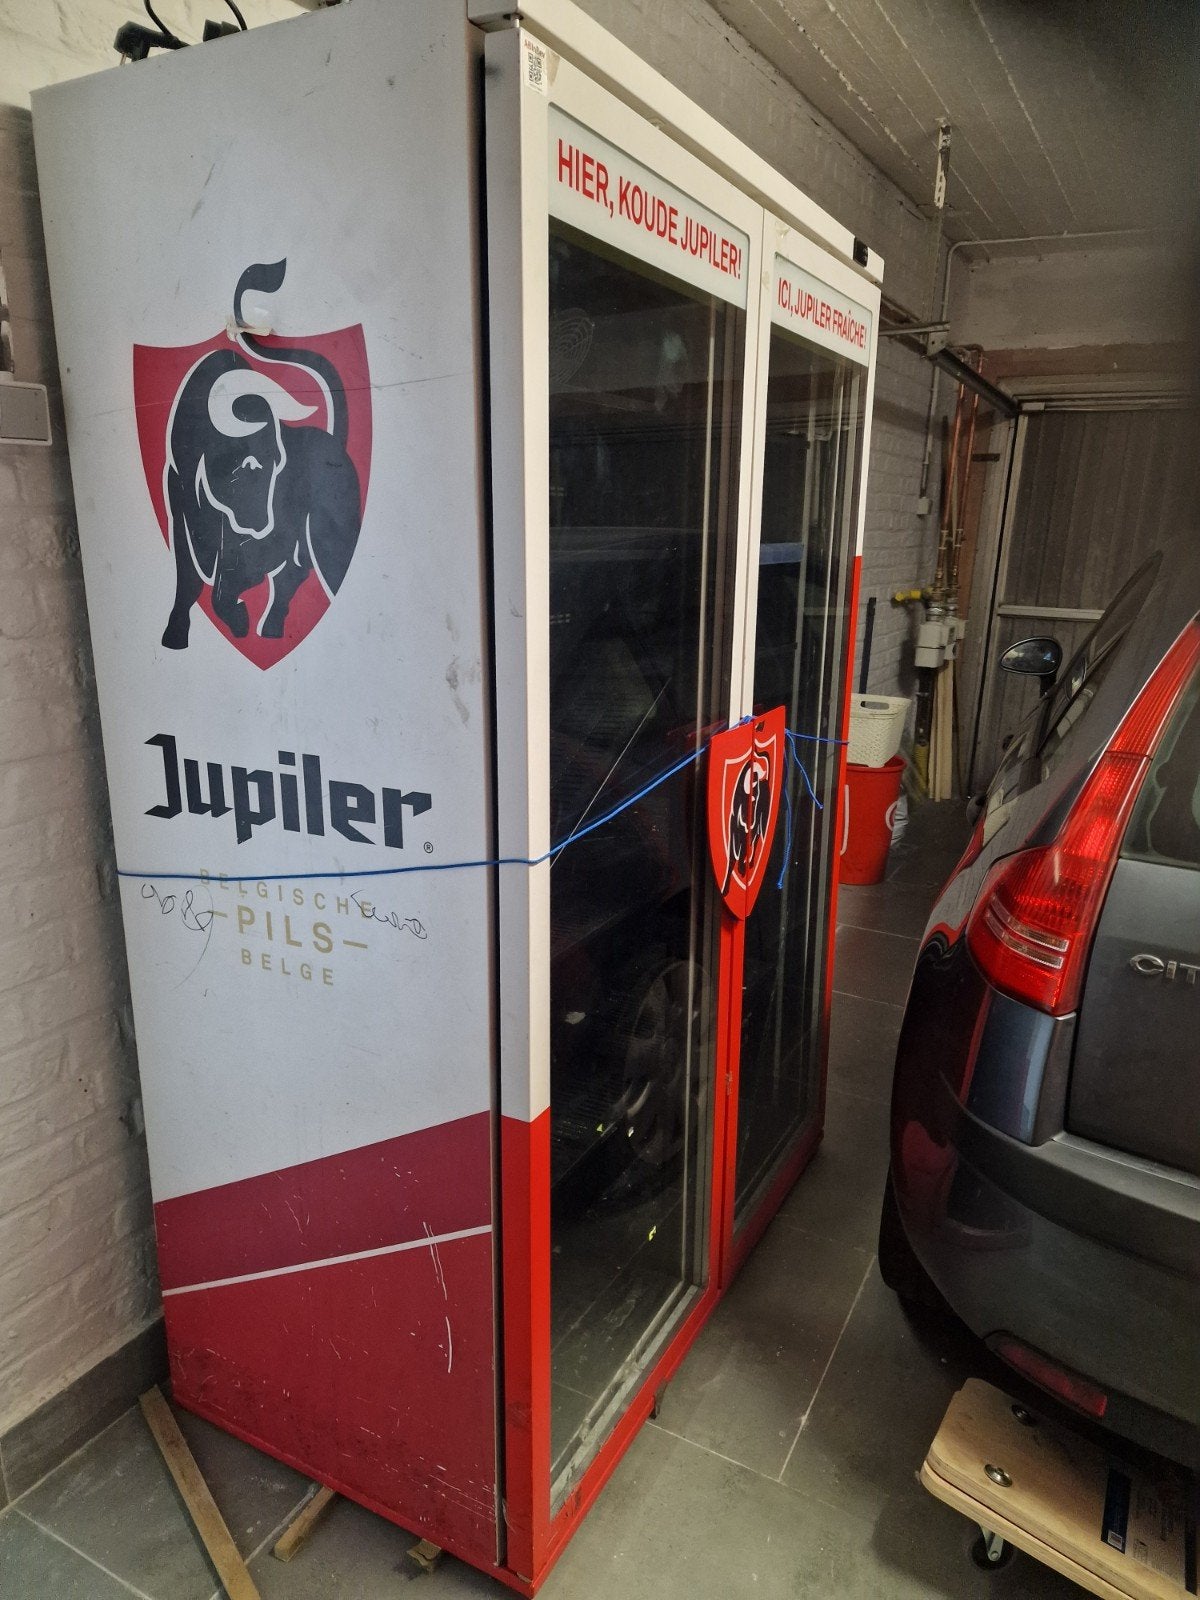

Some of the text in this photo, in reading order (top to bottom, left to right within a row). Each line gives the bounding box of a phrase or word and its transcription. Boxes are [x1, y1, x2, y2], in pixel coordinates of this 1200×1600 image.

[558, 138, 742, 280] HIER, KOUDE JUPILER!
[777, 277, 867, 350] ICI, JUPILER FRAÎCHE!
[144, 733, 432, 850] Jupiler
[199, 867, 374, 920] BELGISCHE
[237, 904, 334, 954] PILS
[241, 947, 334, 987] BELGE
